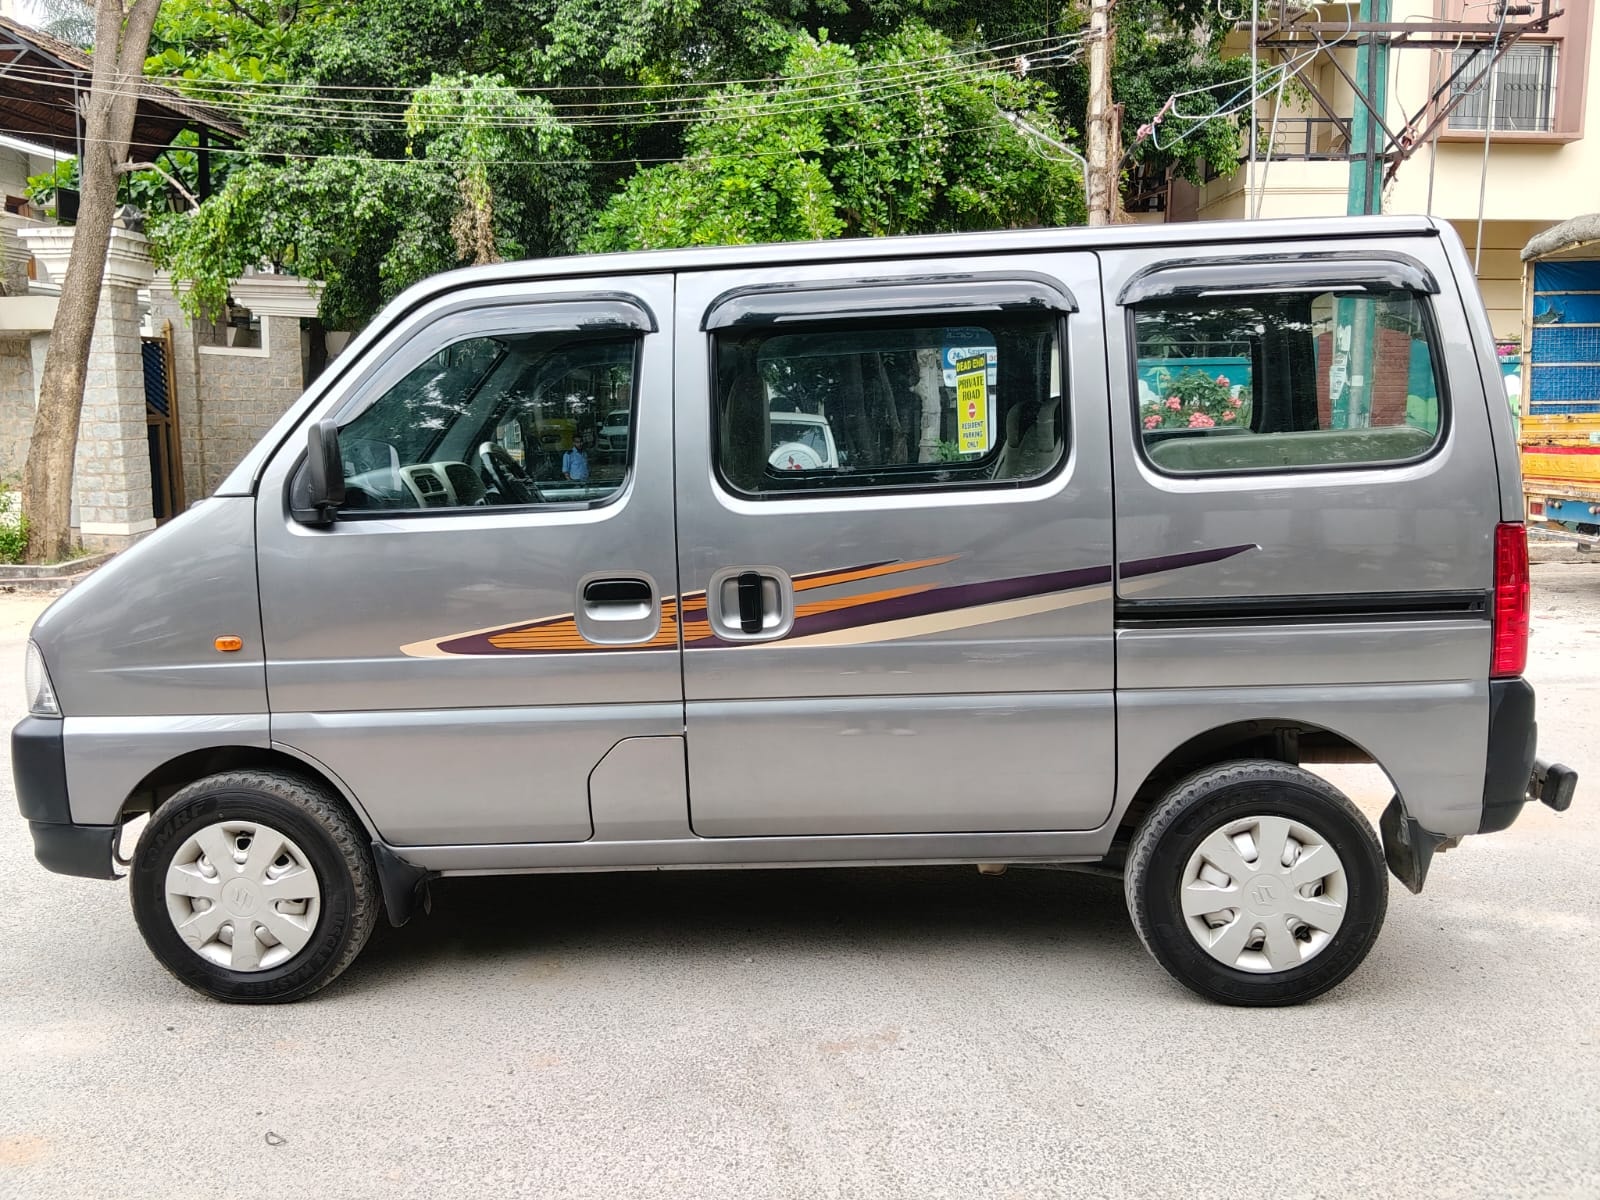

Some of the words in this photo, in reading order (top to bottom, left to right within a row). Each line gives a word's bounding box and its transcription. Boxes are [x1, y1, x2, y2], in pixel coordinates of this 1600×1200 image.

[956, 361, 972, 373] DEAD
[972, 357, 985, 369] END
[958, 375, 985, 391] PRIVATE
[962, 389, 981, 402] ROAD
[961, 420, 984, 430] RESIDENT
[962, 431, 983, 439] PARKING
[966, 440, 979, 448] ONLY
[155, 801, 207, 847] MRF
